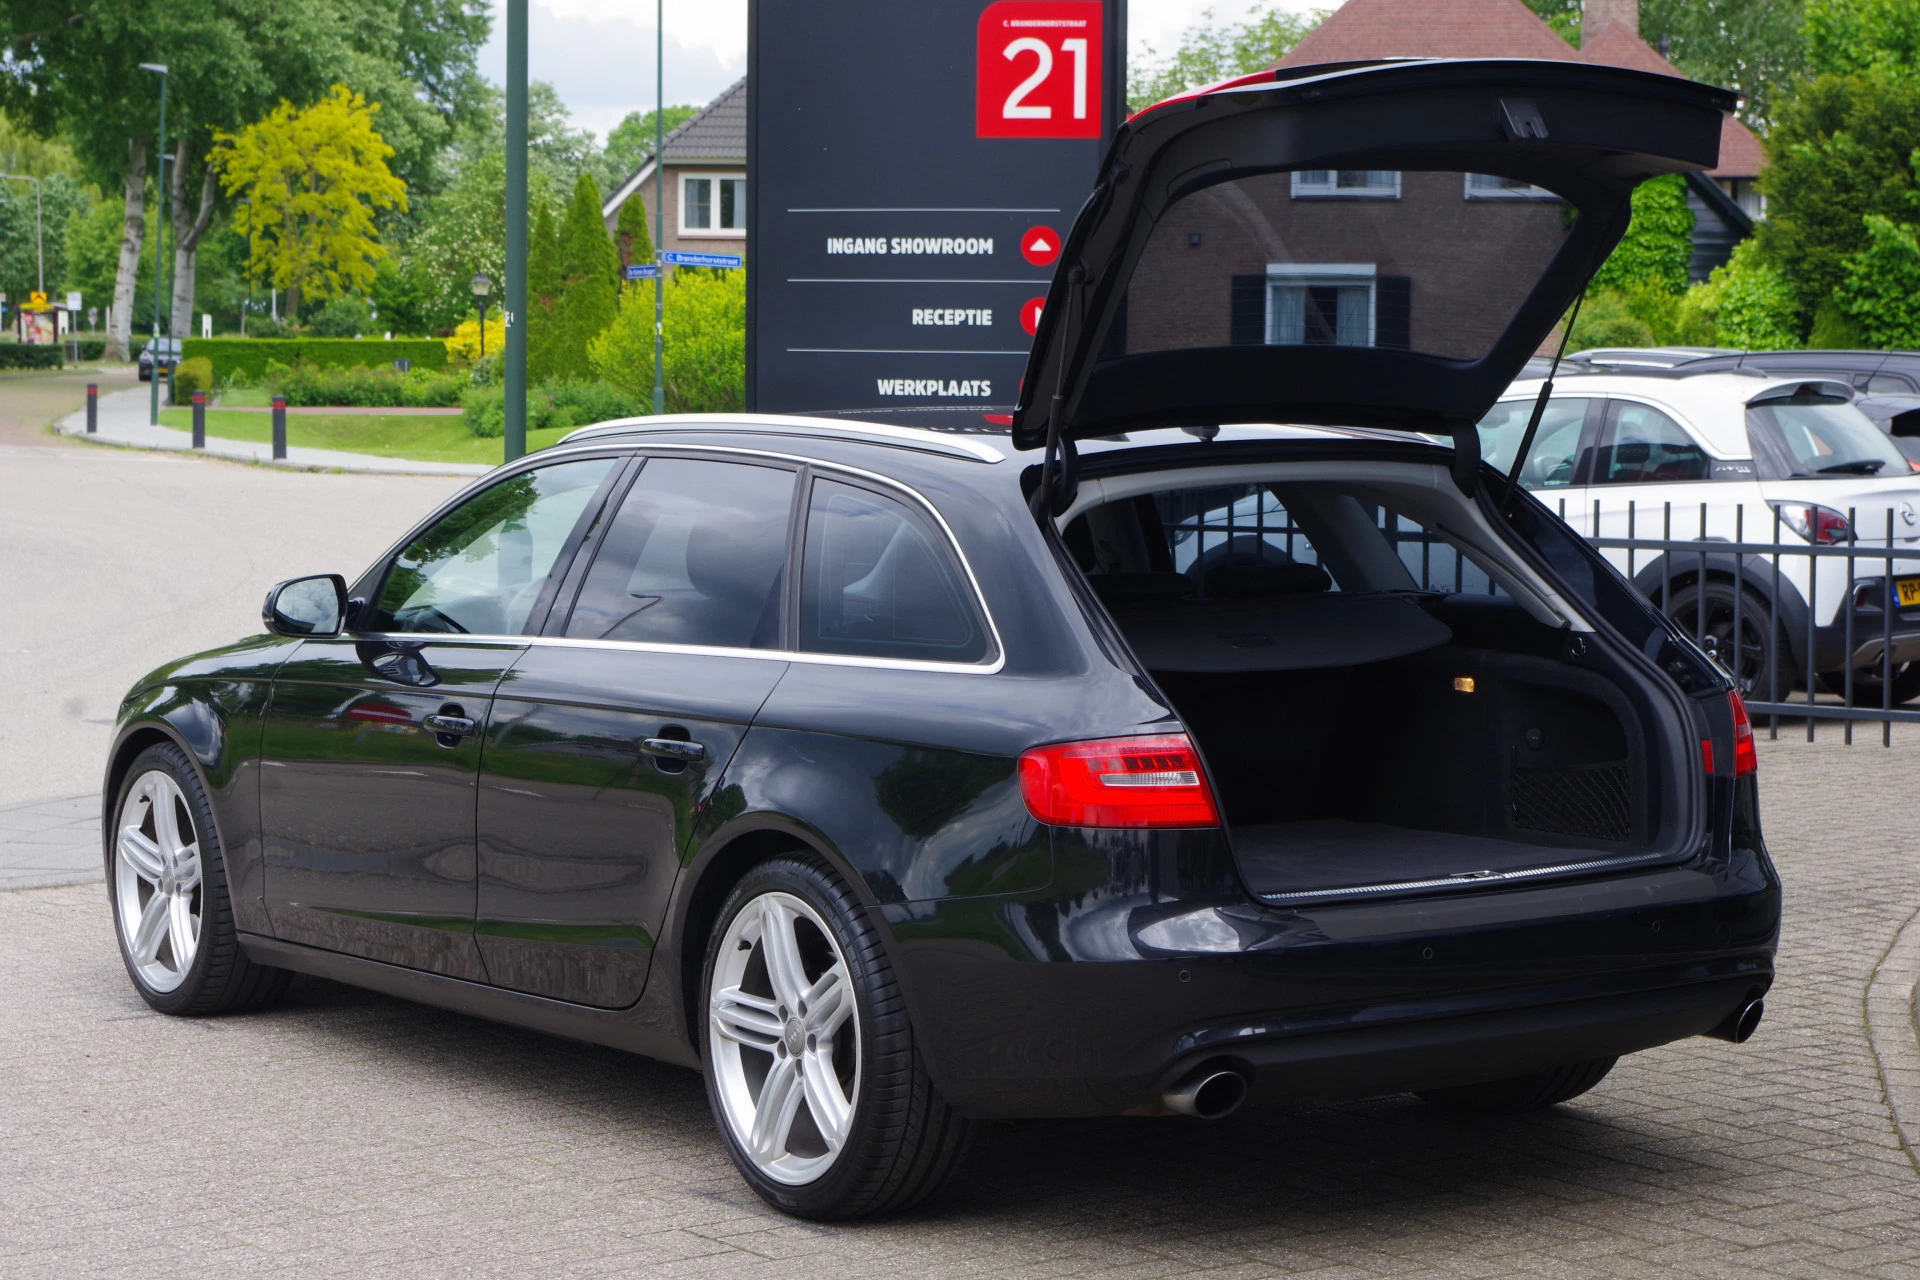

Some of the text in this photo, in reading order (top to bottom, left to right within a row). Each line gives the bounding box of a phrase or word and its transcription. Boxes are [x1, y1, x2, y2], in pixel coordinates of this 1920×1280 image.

[1002, 37, 1088, 119] 21
[827, 237, 994, 255] INGANG SHOWROOM
[912, 308, 993, 326] RECEPTIE
[877, 379, 992, 397] WERKPLAATS
[1902, 582, 1920, 602] RP-
